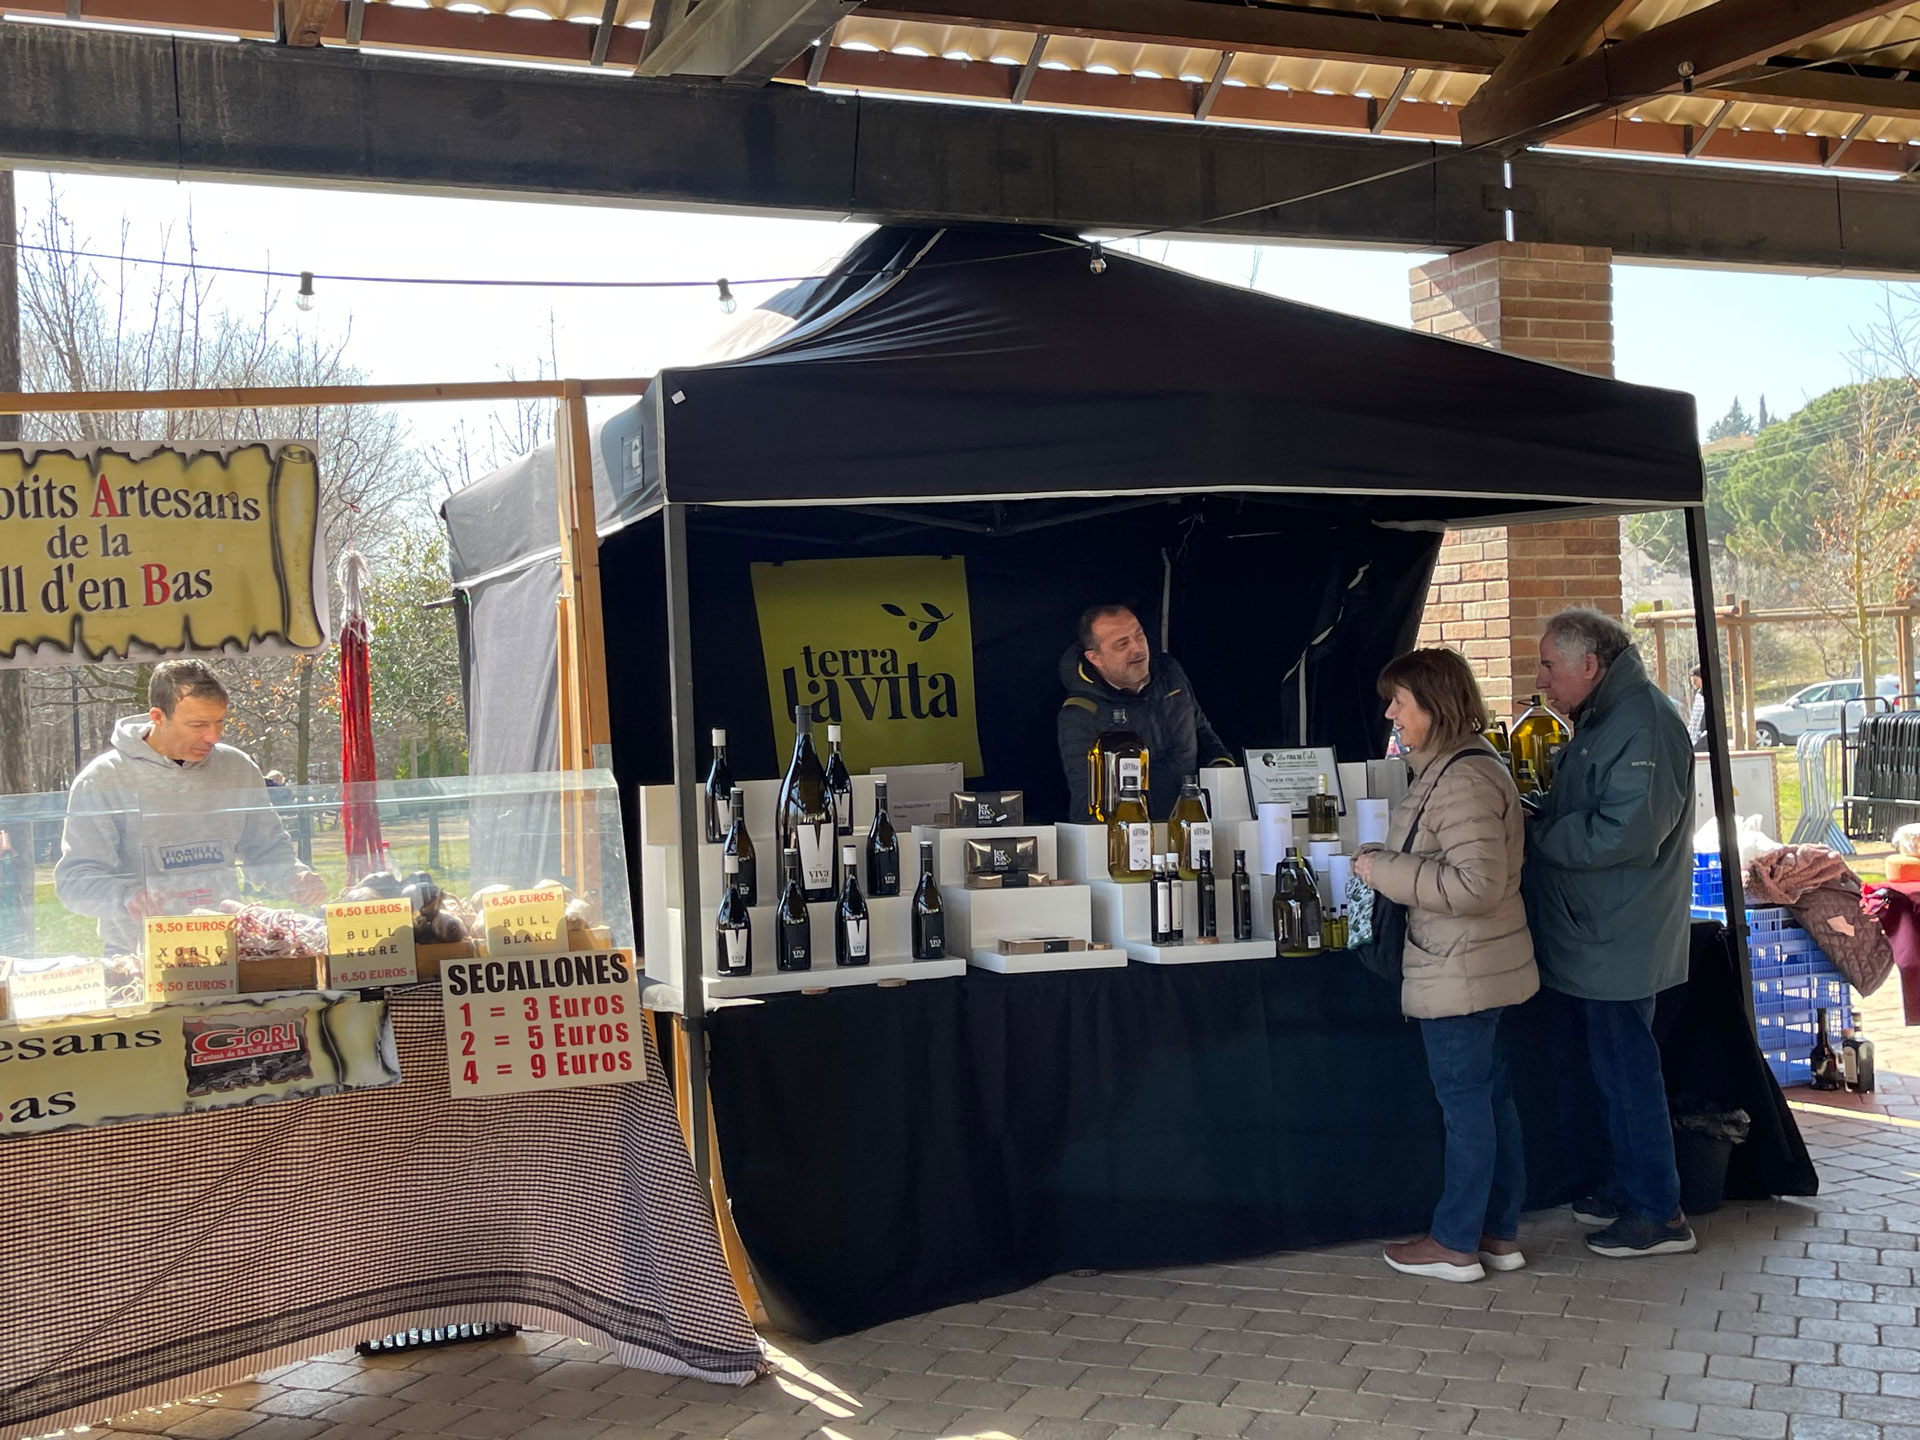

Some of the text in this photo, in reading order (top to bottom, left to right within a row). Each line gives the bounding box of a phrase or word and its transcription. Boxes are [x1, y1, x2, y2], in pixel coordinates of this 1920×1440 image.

[90, 473, 261, 521] Artesans
[46, 524, 132, 559] de la
[0, 563, 213, 614] ll d'en Bas
[800, 645, 899, 678] terra
[335, 906, 362, 917] 6,50
[364, 903, 402, 915] EUROS
[492, 895, 516, 906] 6,50
[519, 892, 555, 904] EUROS
[155, 922, 183, 934] 3,50
[186, 921, 226, 932] EUROS
[503, 915, 550, 928] BULL
[347, 928, 396, 940] BULL
[503, 931, 552, 945] BLANC
[346, 944, 399, 958] NEGRE
[341, 971, 367, 982] 6,50
[369, 967, 407, 980] EUROS
[448, 953, 629, 995] SECALLONES
[156, 981, 183, 993] 3,50
[186, 979, 227, 991] EUROS
[459, 1002, 471, 1027] 1
[523, 996, 539, 1021] 3
[549, 994, 624, 1019] Euros
[460, 1031, 476, 1056] 2
[528, 1025, 544, 1050] 5
[553, 1022, 629, 1048] Euros
[463, 1060, 479, 1085] 4
[530, 1053, 547, 1079] 9
[556, 1050, 632, 1077] Euros
[0, 1091, 76, 1123] as
